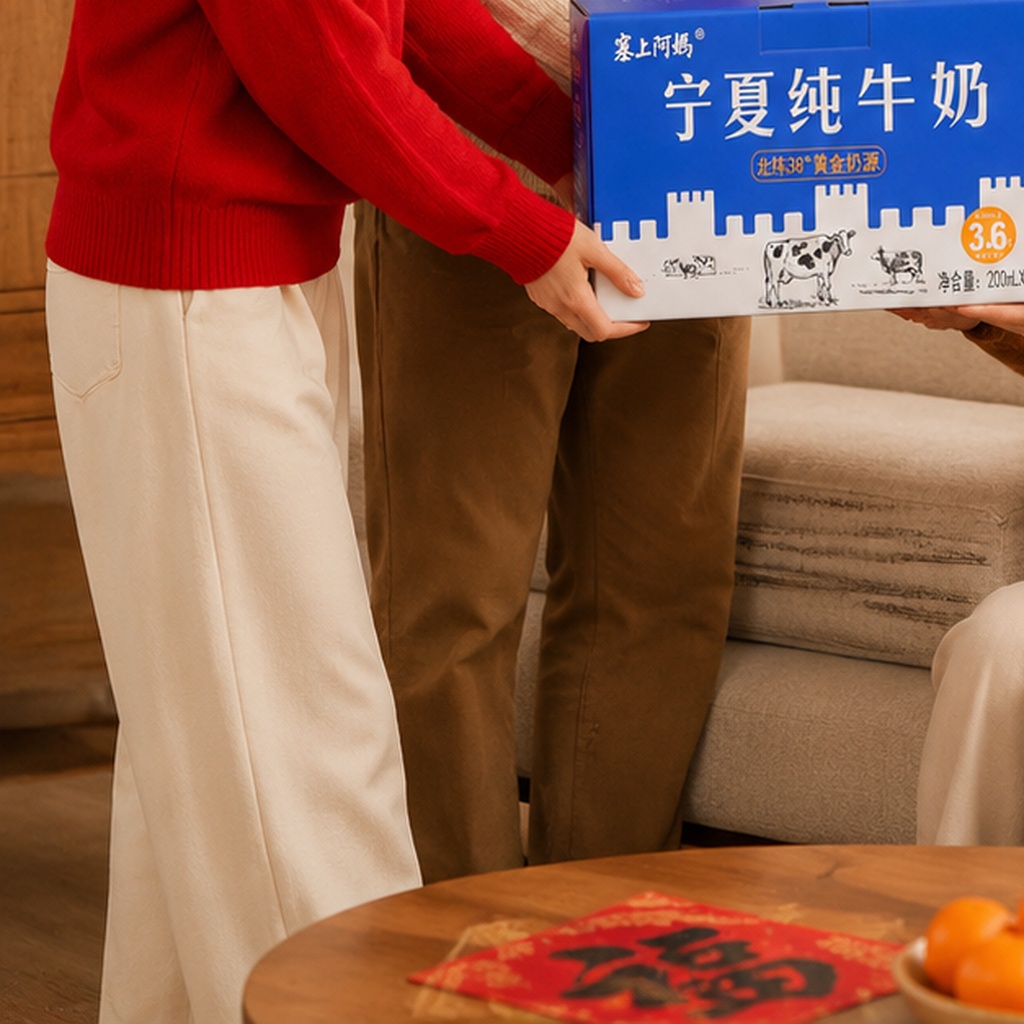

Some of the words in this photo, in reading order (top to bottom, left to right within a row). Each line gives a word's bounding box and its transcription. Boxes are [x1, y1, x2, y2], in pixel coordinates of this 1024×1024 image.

[664, 61, 988, 142] 宁夏纯牛奶
[969, 221, 1008, 251] 3.6
